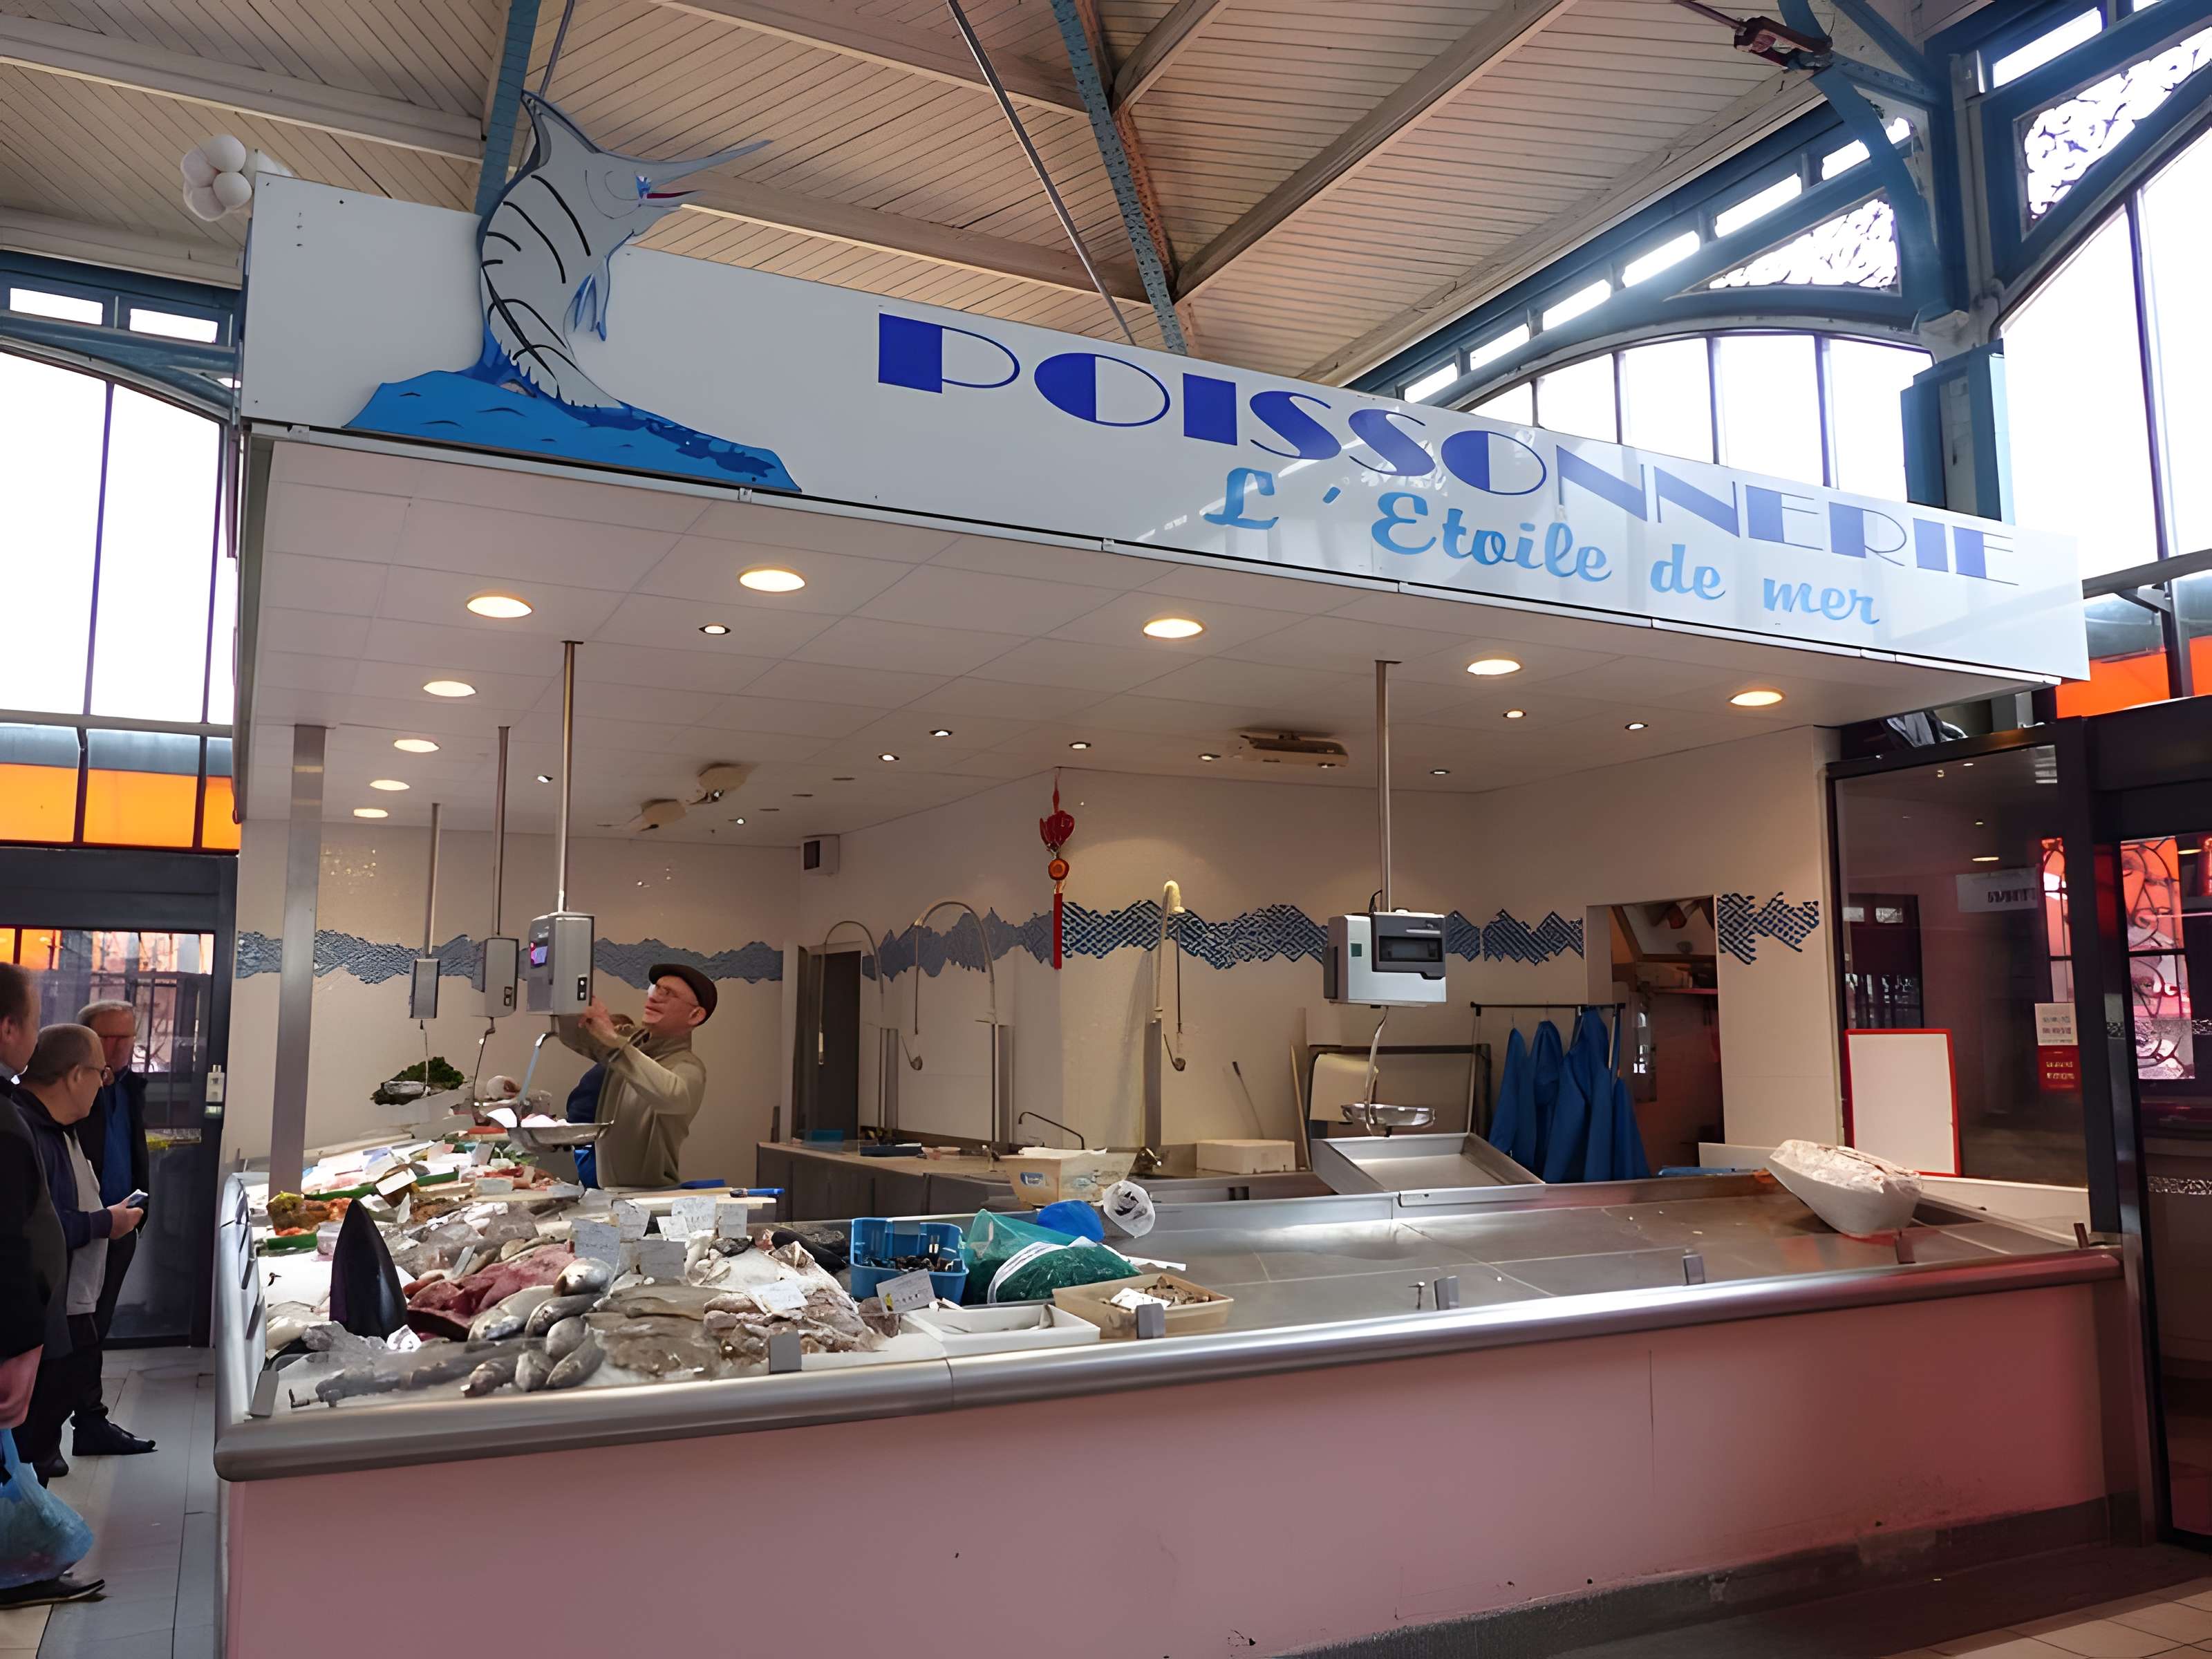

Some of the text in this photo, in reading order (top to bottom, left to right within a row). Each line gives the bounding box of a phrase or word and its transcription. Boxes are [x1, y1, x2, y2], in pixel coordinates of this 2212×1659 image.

[878, 312, 2019, 585] POISSONNERIE
[1650, 543, 1726, 601] de
[1763, 578, 1880, 626] mer
